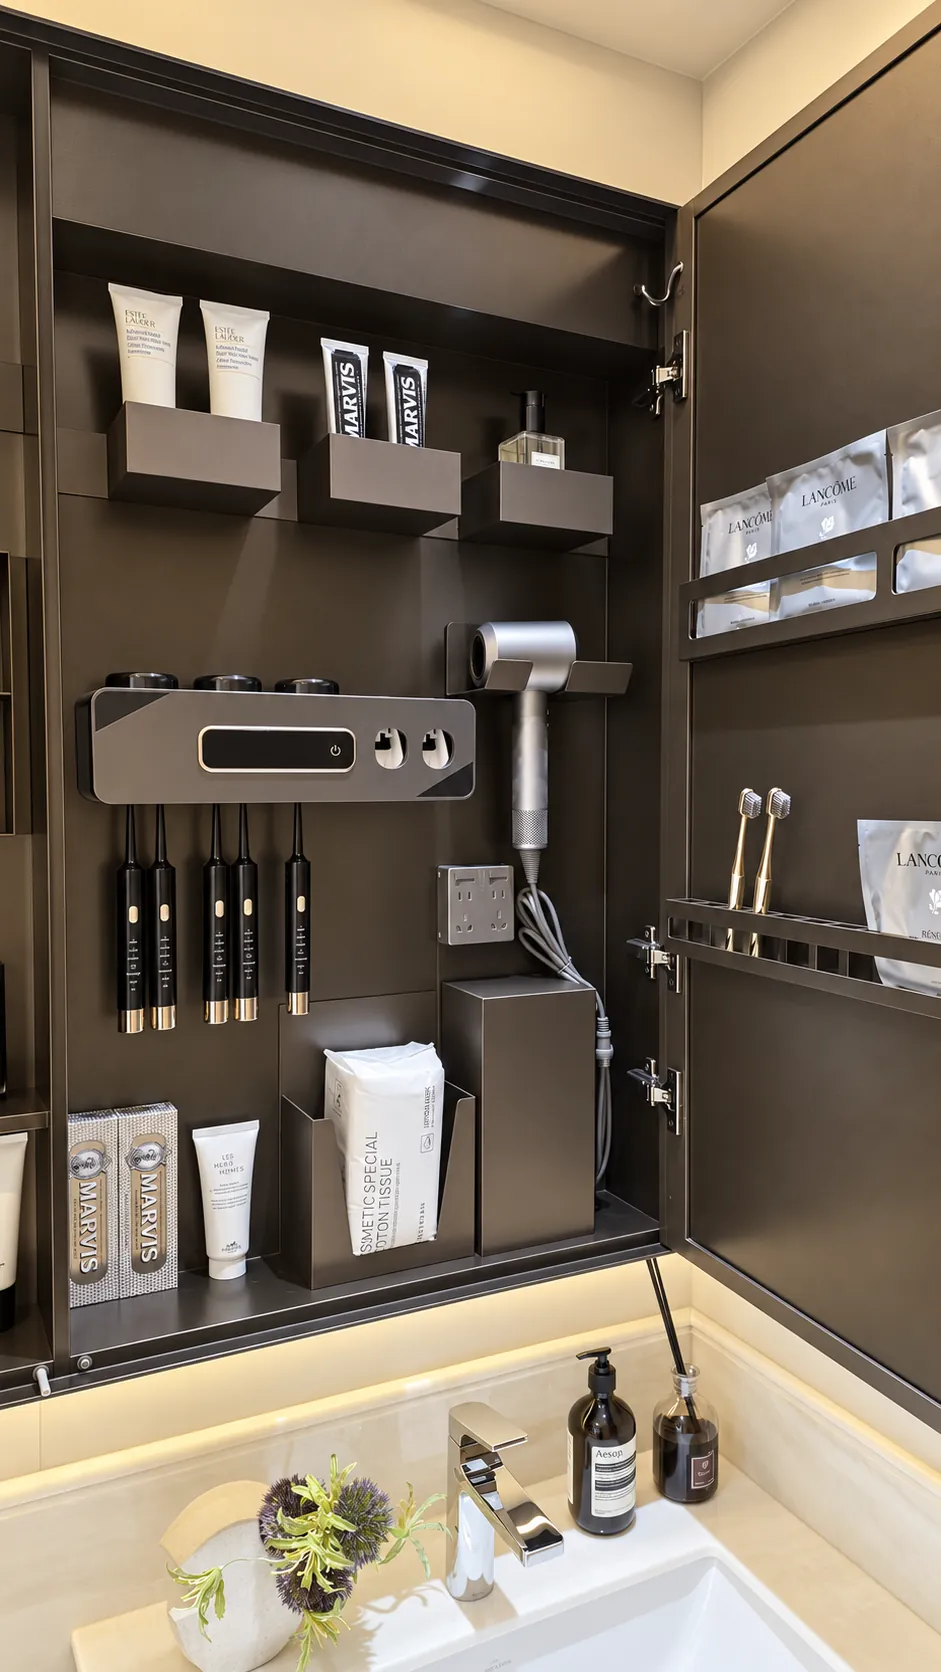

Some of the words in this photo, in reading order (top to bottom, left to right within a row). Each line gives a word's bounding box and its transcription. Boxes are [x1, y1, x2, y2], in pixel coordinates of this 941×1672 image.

[339, 362, 360, 437] MARVIS
[801, 475, 857, 507] LANCÔME
[820, 499, 837, 507] PARIS
[363, 1131, 378, 1193] SPECIAL
[378, 1158, 393, 1209] TISSUE
[79, 1181, 98, 1274] MARVIS
[140, 1173, 159, 1263] MARVIS
[595, 1450, 623, 1459] Aesop
